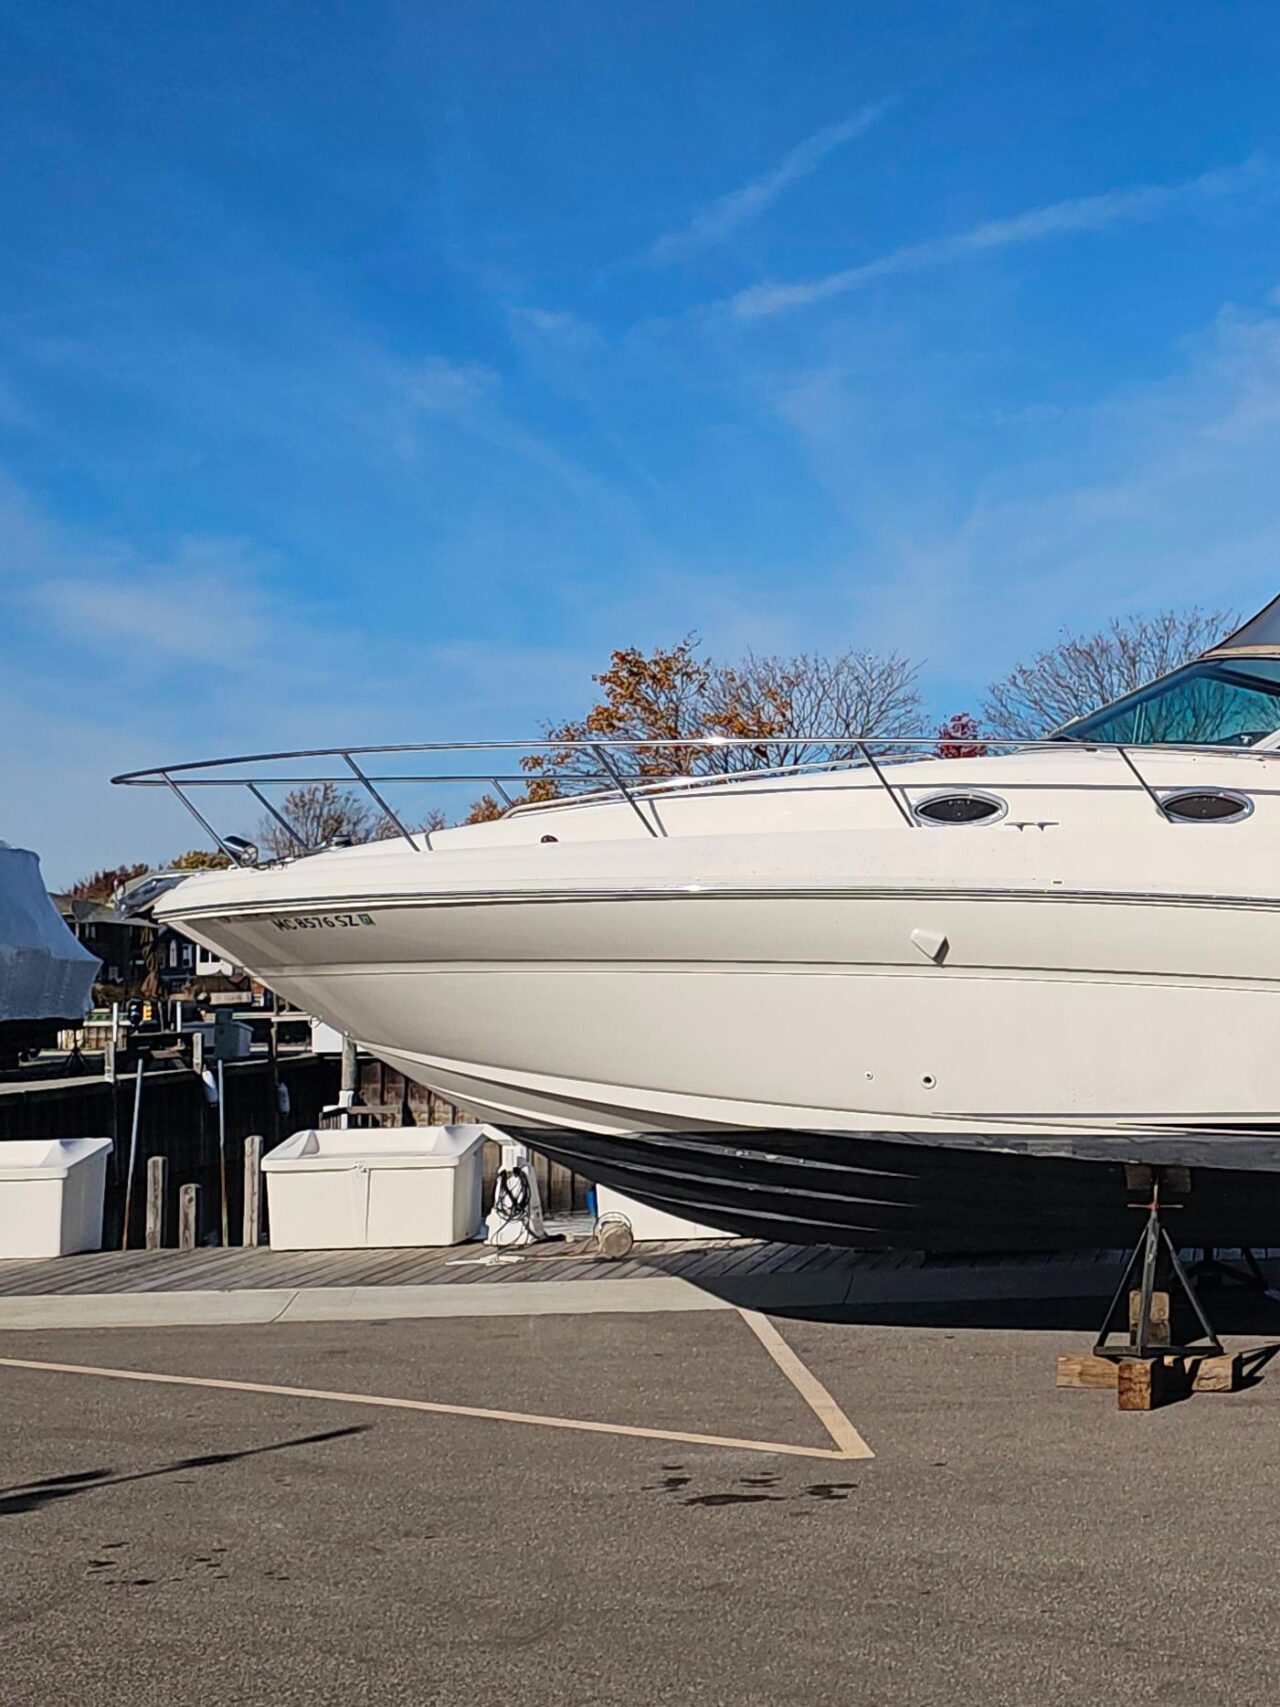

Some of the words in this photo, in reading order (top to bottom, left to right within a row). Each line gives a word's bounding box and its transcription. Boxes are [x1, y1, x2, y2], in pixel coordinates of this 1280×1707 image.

[272, 918, 297, 931] MC
[298, 916, 335, 928] 8576
[335, 914, 359, 927] SZ
